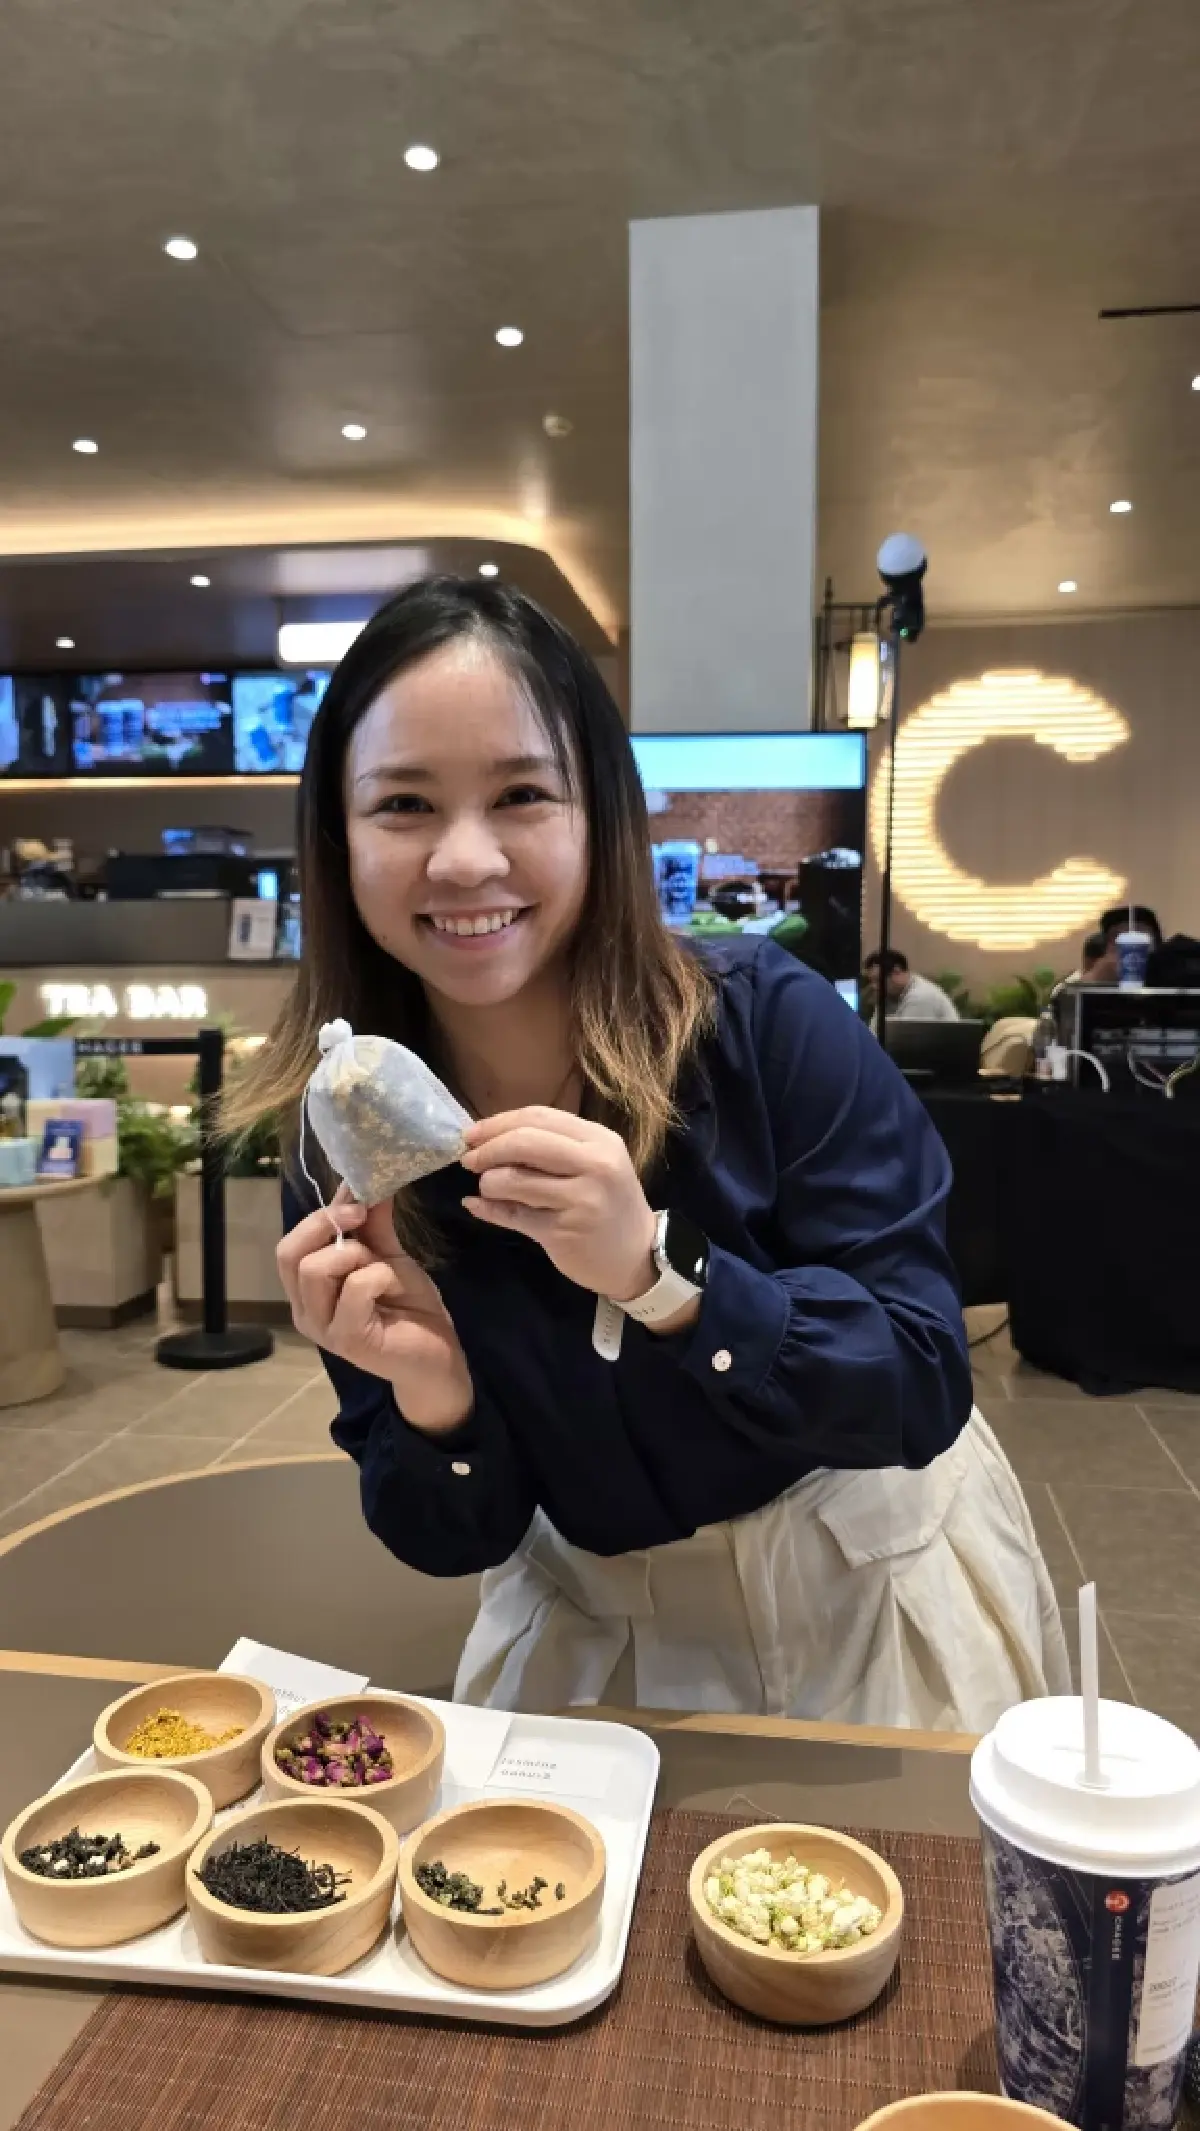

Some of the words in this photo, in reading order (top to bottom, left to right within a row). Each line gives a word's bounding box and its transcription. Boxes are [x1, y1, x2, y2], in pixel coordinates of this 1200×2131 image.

[869, 667, 1131, 951] C
[41, 983, 119, 1018] TEA
[126, 983, 209, 1019] BAR
